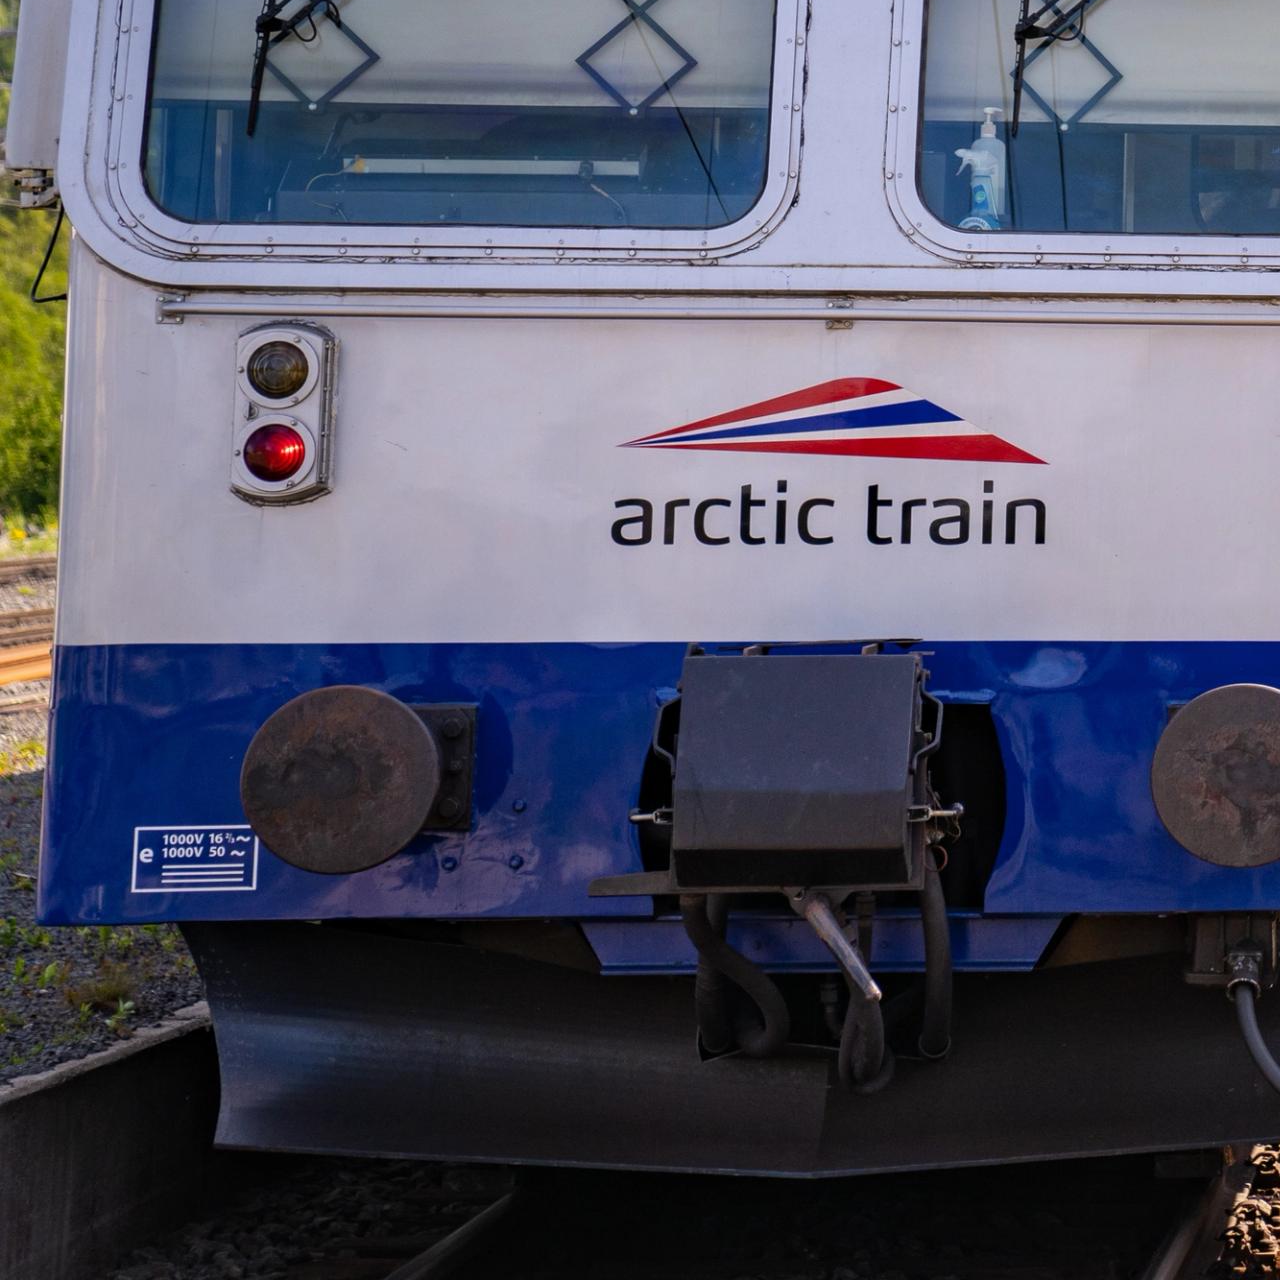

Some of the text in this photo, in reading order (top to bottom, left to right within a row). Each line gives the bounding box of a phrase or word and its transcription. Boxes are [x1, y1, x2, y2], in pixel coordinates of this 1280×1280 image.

[610, 480, 1046, 546] arctic train
[162, 833, 205, 845] 1000V
[139, 848, 154, 863] e
[161, 847, 204, 858] 1000V
[208, 846, 226, 857] 50
